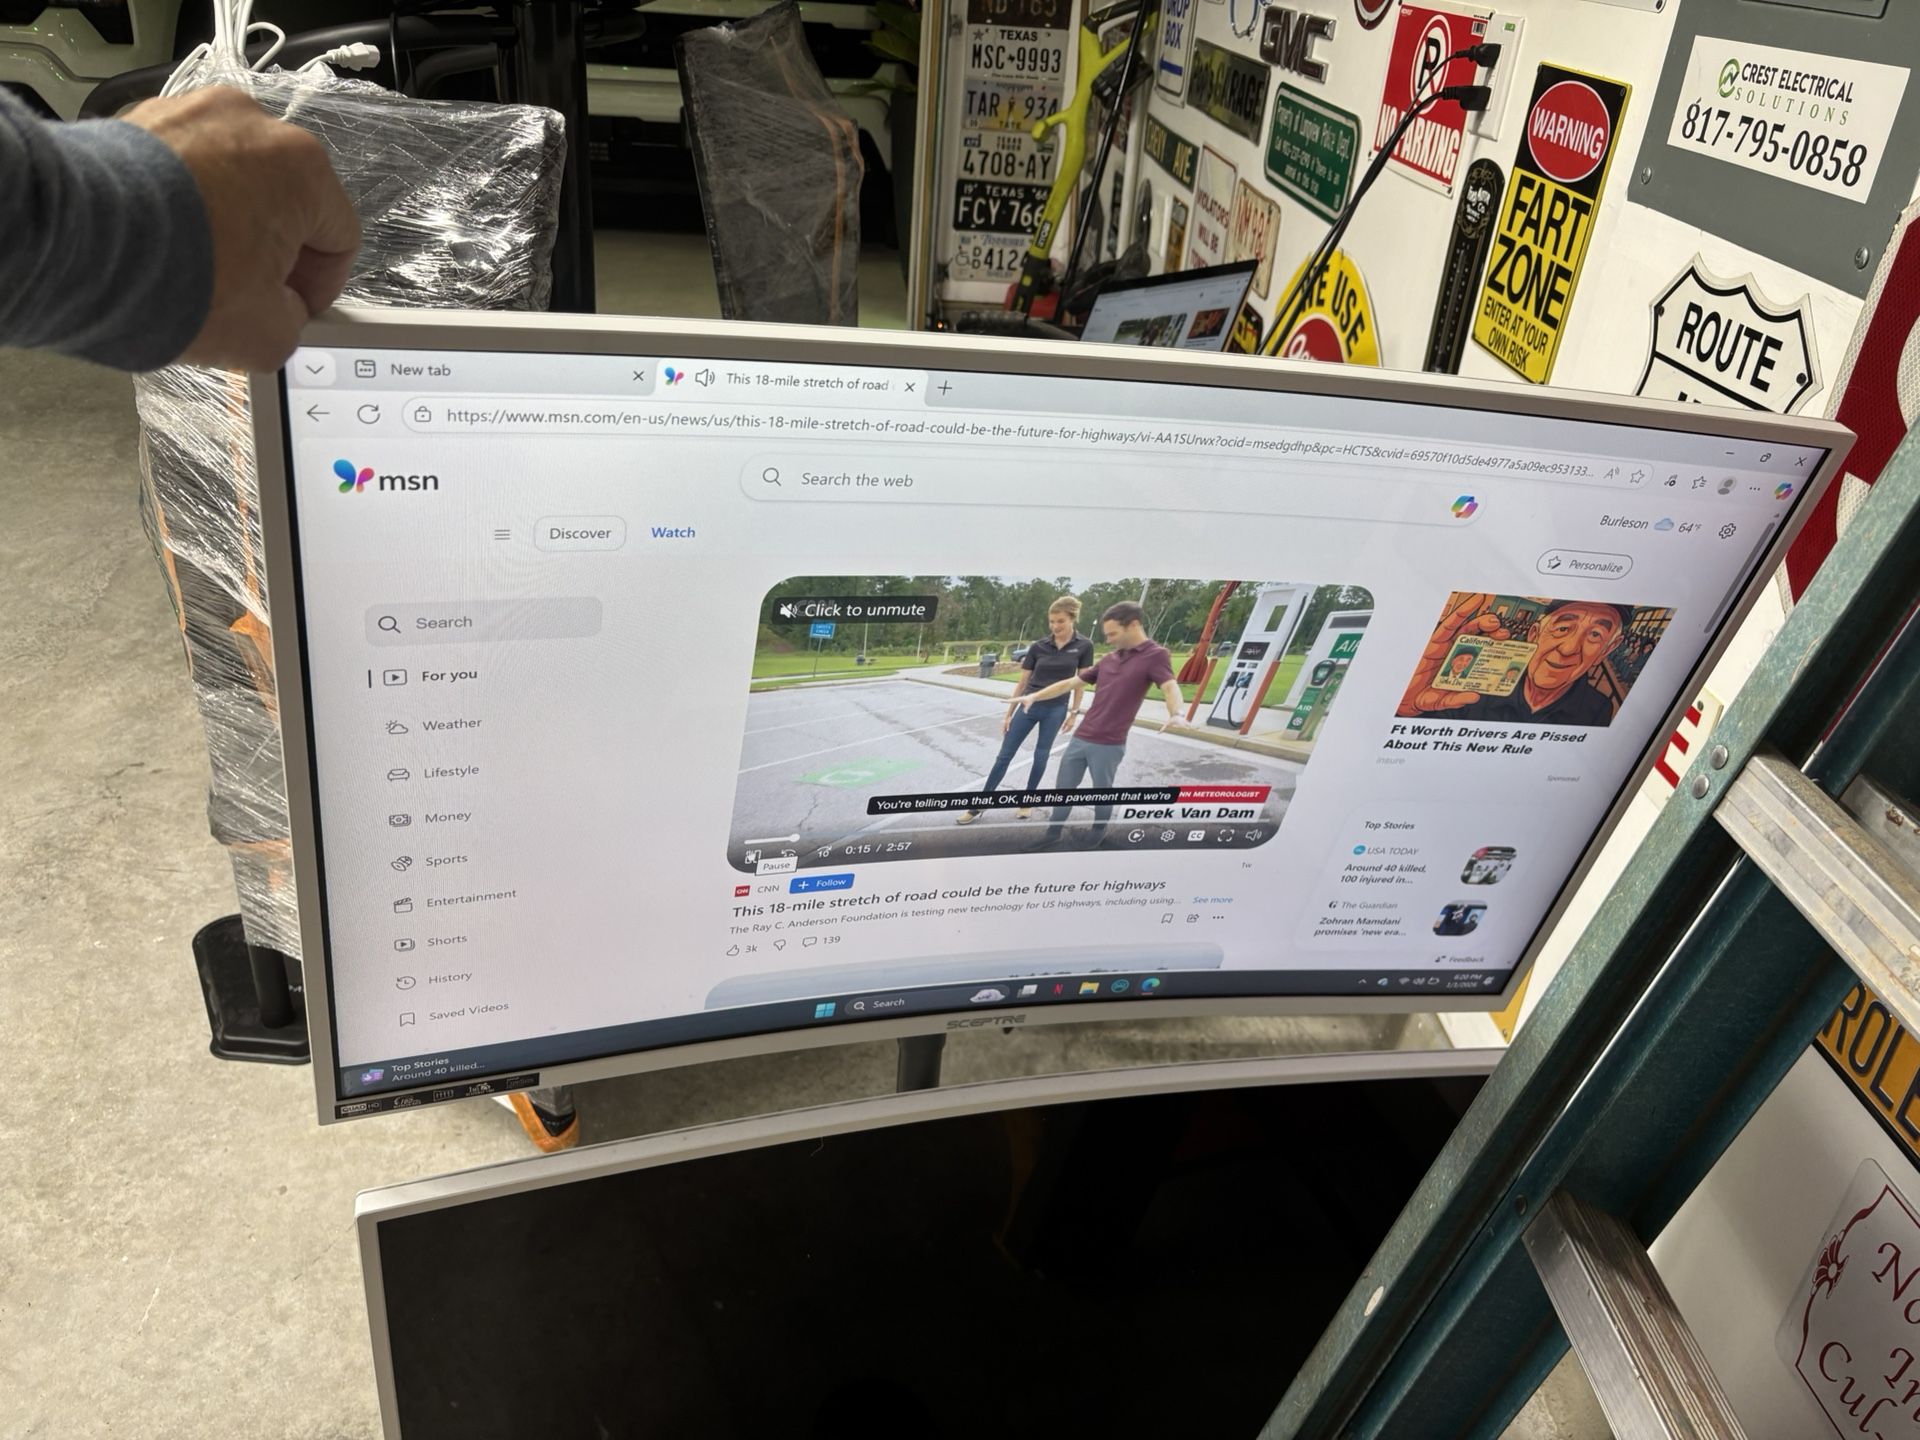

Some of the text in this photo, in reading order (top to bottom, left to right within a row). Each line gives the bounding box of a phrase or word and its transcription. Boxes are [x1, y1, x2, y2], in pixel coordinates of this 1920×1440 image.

[1000, 29, 1038, 42] TEXAS
[1164, 20, 1184, 49] BOX
[1260, 5, 1337, 85] GMC
[972, 43, 1061, 73] MSC 9993
[1741, 62, 1854, 104] CREST ELECTRICAL
[966, 90, 1000, 118] TAR
[1734, 87, 1849, 127] SOLUTIONS
[1532, 106, 1605, 160] WARNING
[1395, 110, 1461, 180] PARKING
[1681, 102, 1868, 188] 817-795-0858
[963, 149, 1052, 181] 4708 AY
[985, 185, 1026, 197] TEXAS
[957, 196, 1001, 225] FCY
[1198, 189, 1230, 229] VIOLATORS
[1506, 173, 1594, 263] FART
[1487, 236, 1573, 331] ZONE
[1331, 269, 1366, 359] USE
[1483, 295, 1549, 357] ENTER AT YOUR
[1487, 326, 1531, 374] OWN RISK
[1675, 301, 1784, 393] ROUTE
[390, 363, 451, 377] New tab
[726, 373, 889, 392] This 18-mile stretch of road
[378, 473, 440, 492] msn
[801, 472, 914, 489] Search the web
[1600, 514, 1649, 531] Burleson
[549, 526, 612, 541] Discover
[651, 525, 697, 539] Watch
[1568, 559, 1624, 574] Personalize
[804, 603, 927, 618] Click to unmute
[415, 615, 474, 630] Search
[1459, 636, 1495, 647] California
[422, 669, 479, 685] For you
[422, 718, 483, 732] Weather
[1390, 724, 1588, 743] Ft Worth Drivers Are Pissed
[1383, 739, 1533, 756] About This New Rule
[423, 764, 480, 779] Lifestyle
[876, 799, 912, 810] You're
[914, 798, 948, 809] telling
[950, 799, 969, 807] me
[1022, 794, 1042, 804] this
[1044, 793, 1063, 803] this
[1065, 793, 1118, 804] pavement
[1120, 791, 1141, 801] that
[1143, 791, 1171, 801] we're
[1192, 790, 1260, 798] METEOROLOGIST
[424, 810, 472, 824] Money
[1123, 806, 1255, 820] Derek Van Dam
[1364, 821, 1415, 831] Top Stories
[845, 841, 912, 855] 0:15 2:57
[1367, 847, 1420, 856] USA TODAY
[425, 853, 469, 867] Sports
[762, 860, 791, 871] Pause
[1344, 863, 1382, 873] Around
[1384, 864, 1398, 873] 40
[815, 877, 847, 888] Follow
[1340, 875, 1357, 884] 100
[1358, 875, 1395, 885] injured
[756, 884, 780, 894] CNN
[426, 888, 518, 908] Entertainment
[732, 879, 1167, 918] This 18-mile stretch of road could be the future for highways
[1192, 896, 1234, 904] See more
[1340, 901, 1398, 909] The Guardian
[730, 925, 750, 936] The
[752, 922, 773, 934] Ray
[788, 915, 838, 929] Anderson
[840, 910, 898, 924] Foundation
[900, 910, 909, 918] is
[911, 907, 945, 918] testing
[947, 907, 968, 915] new
[970, 901, 1023, 914] technology
[1025, 900, 1040, 910] for
[1042, 899, 1056, 909] US
[1104, 896, 1147, 908] including
[1319, 917, 1402, 926] Zohran Mamdani
[1313, 928, 1358, 937] promises
[427, 934, 468, 948] Shorts
[428, 971, 473, 985] History
[429, 1001, 510, 1021] Saved Videos
[873, 997, 906, 1009] Search
[946, 1013, 1027, 1030] SCEPTRE
[391, 1058, 450, 1073] Top Stories
[392, 1069, 432, 1082] Around
[433, 1066, 448, 1076] 40
[1818, 1340, 1900, 1440] Cul
